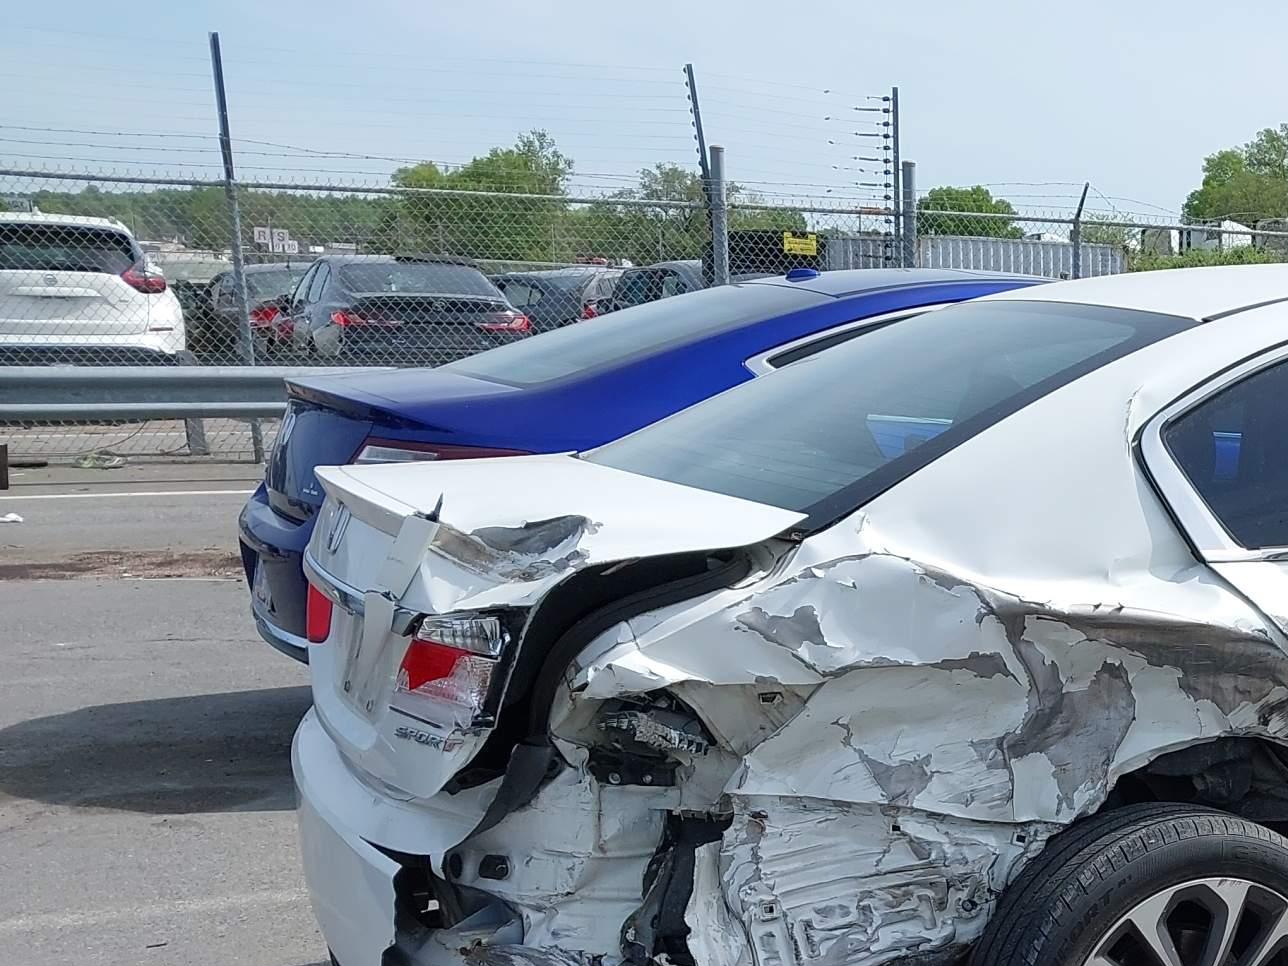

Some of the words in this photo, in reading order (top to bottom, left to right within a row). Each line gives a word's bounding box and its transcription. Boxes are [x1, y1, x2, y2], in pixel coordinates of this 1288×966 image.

[257, 230, 267, 241] R
[277, 231, 285, 242] S
[394, 726, 465, 752] SPORT
